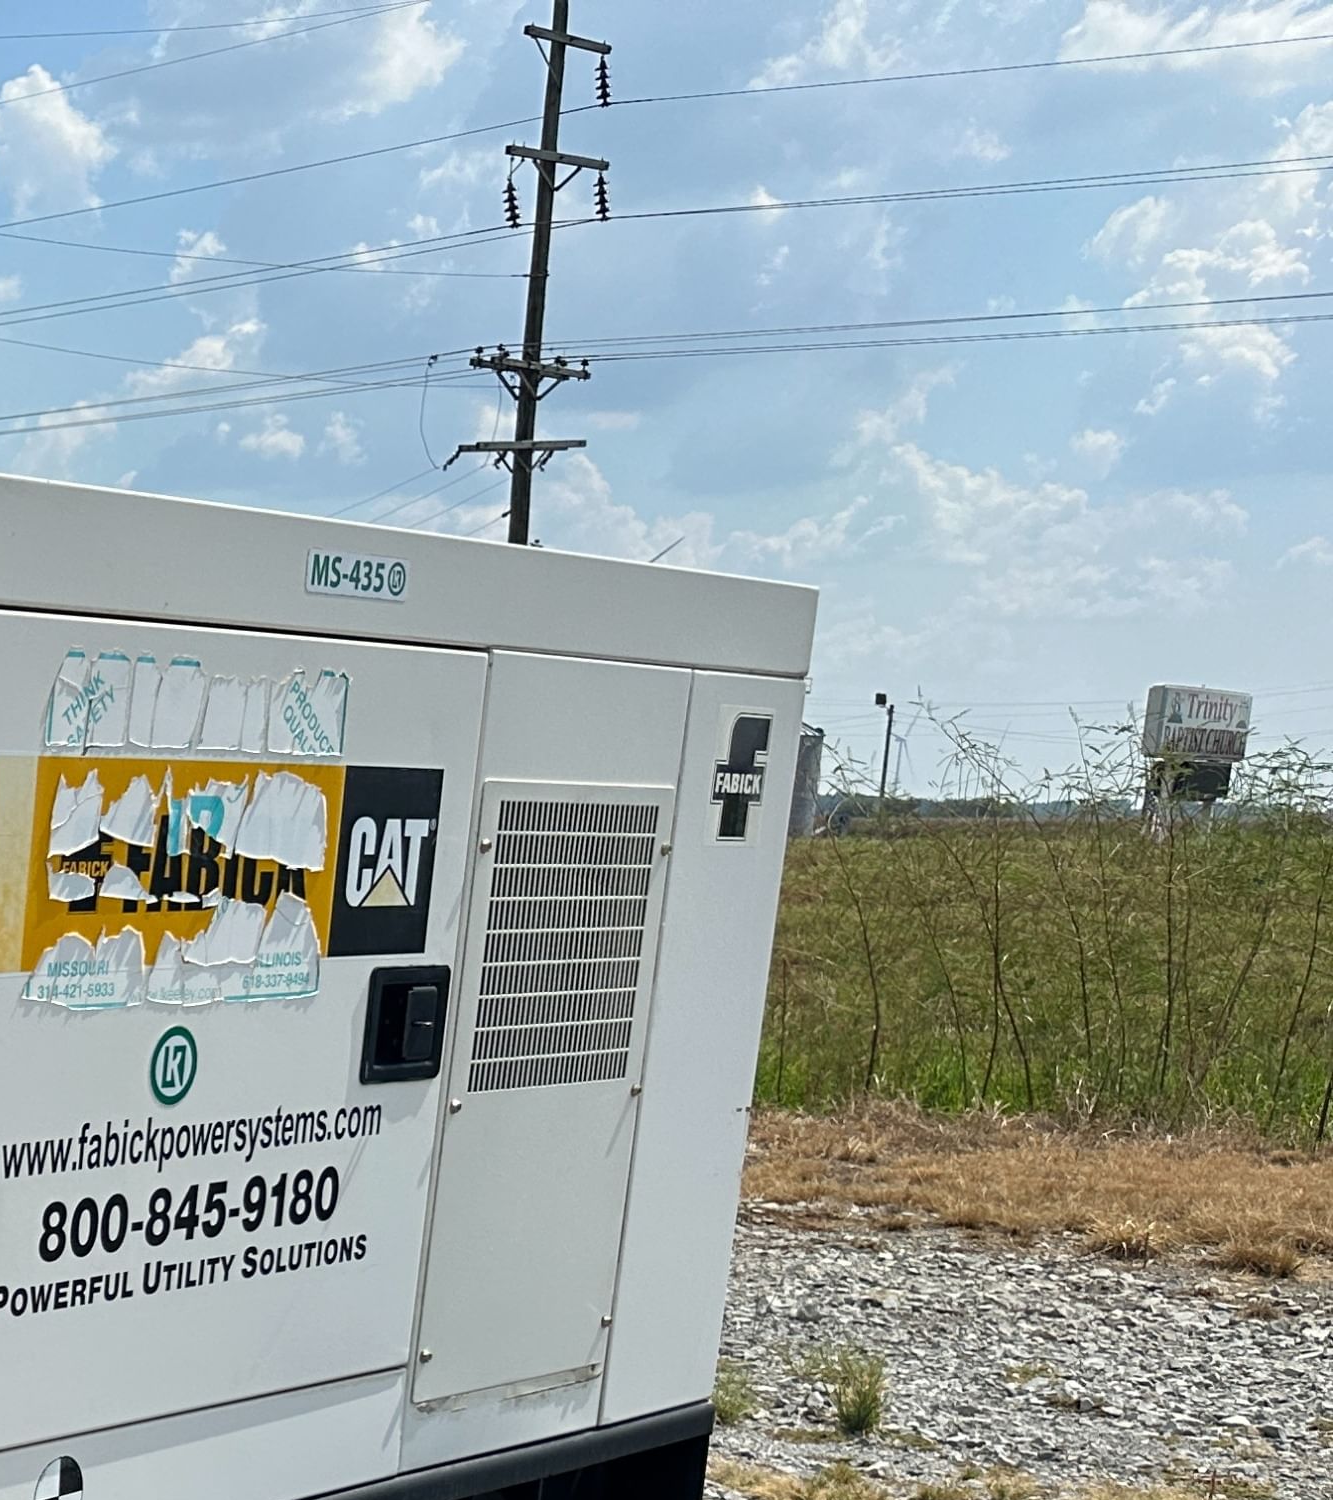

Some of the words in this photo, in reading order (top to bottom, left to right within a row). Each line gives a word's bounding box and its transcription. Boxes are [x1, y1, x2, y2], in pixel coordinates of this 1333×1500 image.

[310, 553, 385, 592] MS-435
[62, 670, 105, 726] THINK
[67, 684, 115, 746] SAETY
[1187, 693, 1238, 728] Trinity
[1164, 725, 1206, 753] BAPTIST
[714, 772, 762, 795] FABICK
[345, 815, 430, 908] CAT
[37, 982, 115, 999] 314-421-5933
[47, 959, 110, 978] MISSOURI
[1, 1102, 382, 1180] www.fabickpowersystems.com
[38, 1166, 339, 1263] 800-845-9180
[142, 1253, 235, 1297] UTILITY
[240, 1233, 368, 1280] SOLUTIONS
